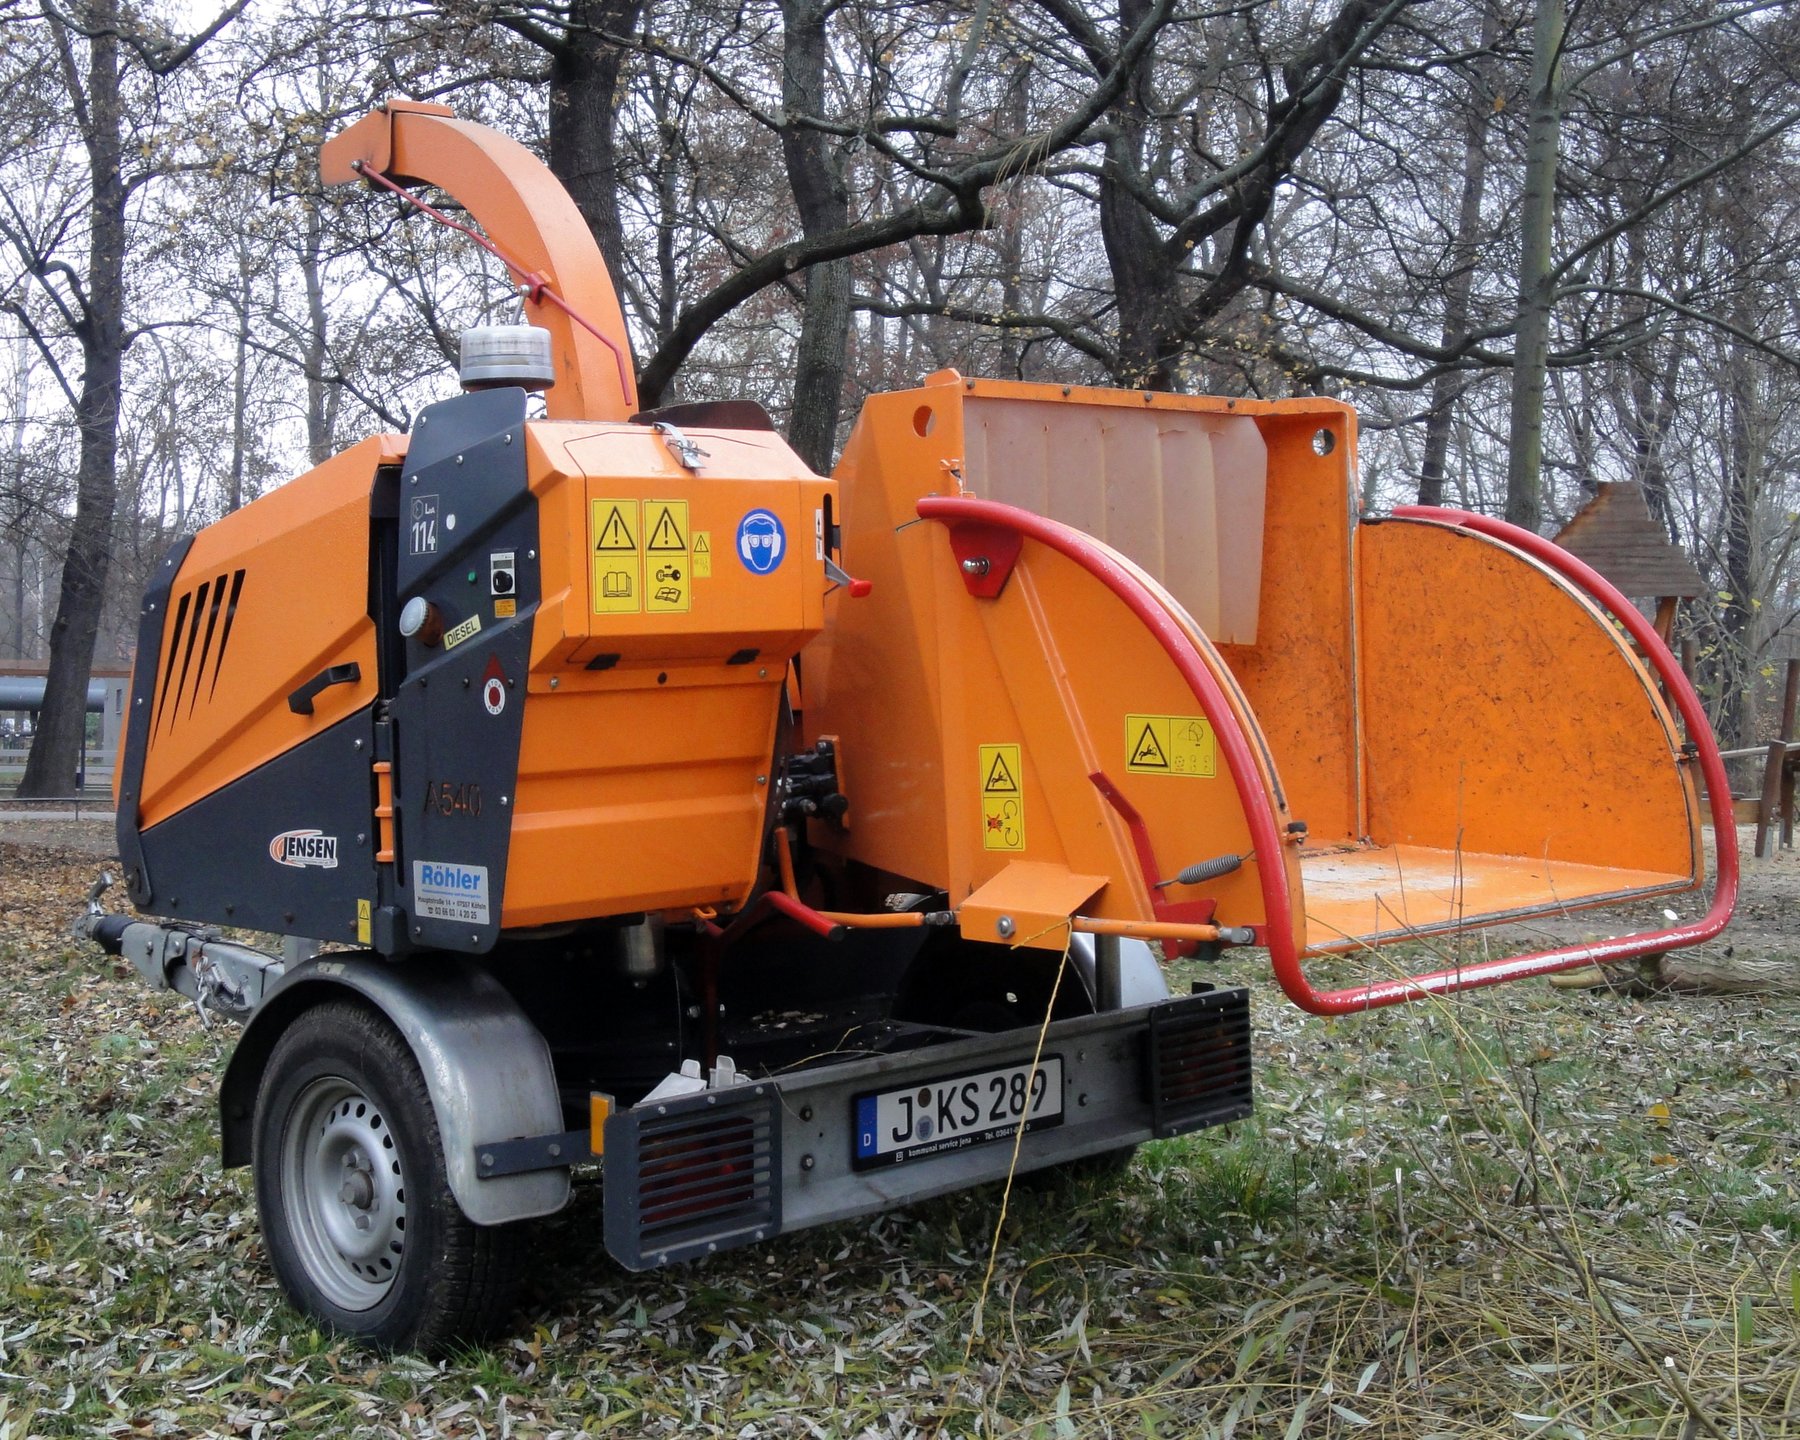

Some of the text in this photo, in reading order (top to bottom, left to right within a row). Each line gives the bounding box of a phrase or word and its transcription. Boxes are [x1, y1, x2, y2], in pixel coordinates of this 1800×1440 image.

[412, 520, 436, 552] 114
[447, 620, 477, 646] DIESEL
[424, 781, 481, 816] A540
[280, 836, 335, 862] JENSEN
[421, 864, 481, 891] Röhler
[892, 1069, 1047, 1142] J KS 289
[863, 1133, 872, 1147] D
[908, 1144, 937, 1157] kommunal
[939, 1140, 958, 1150] service
